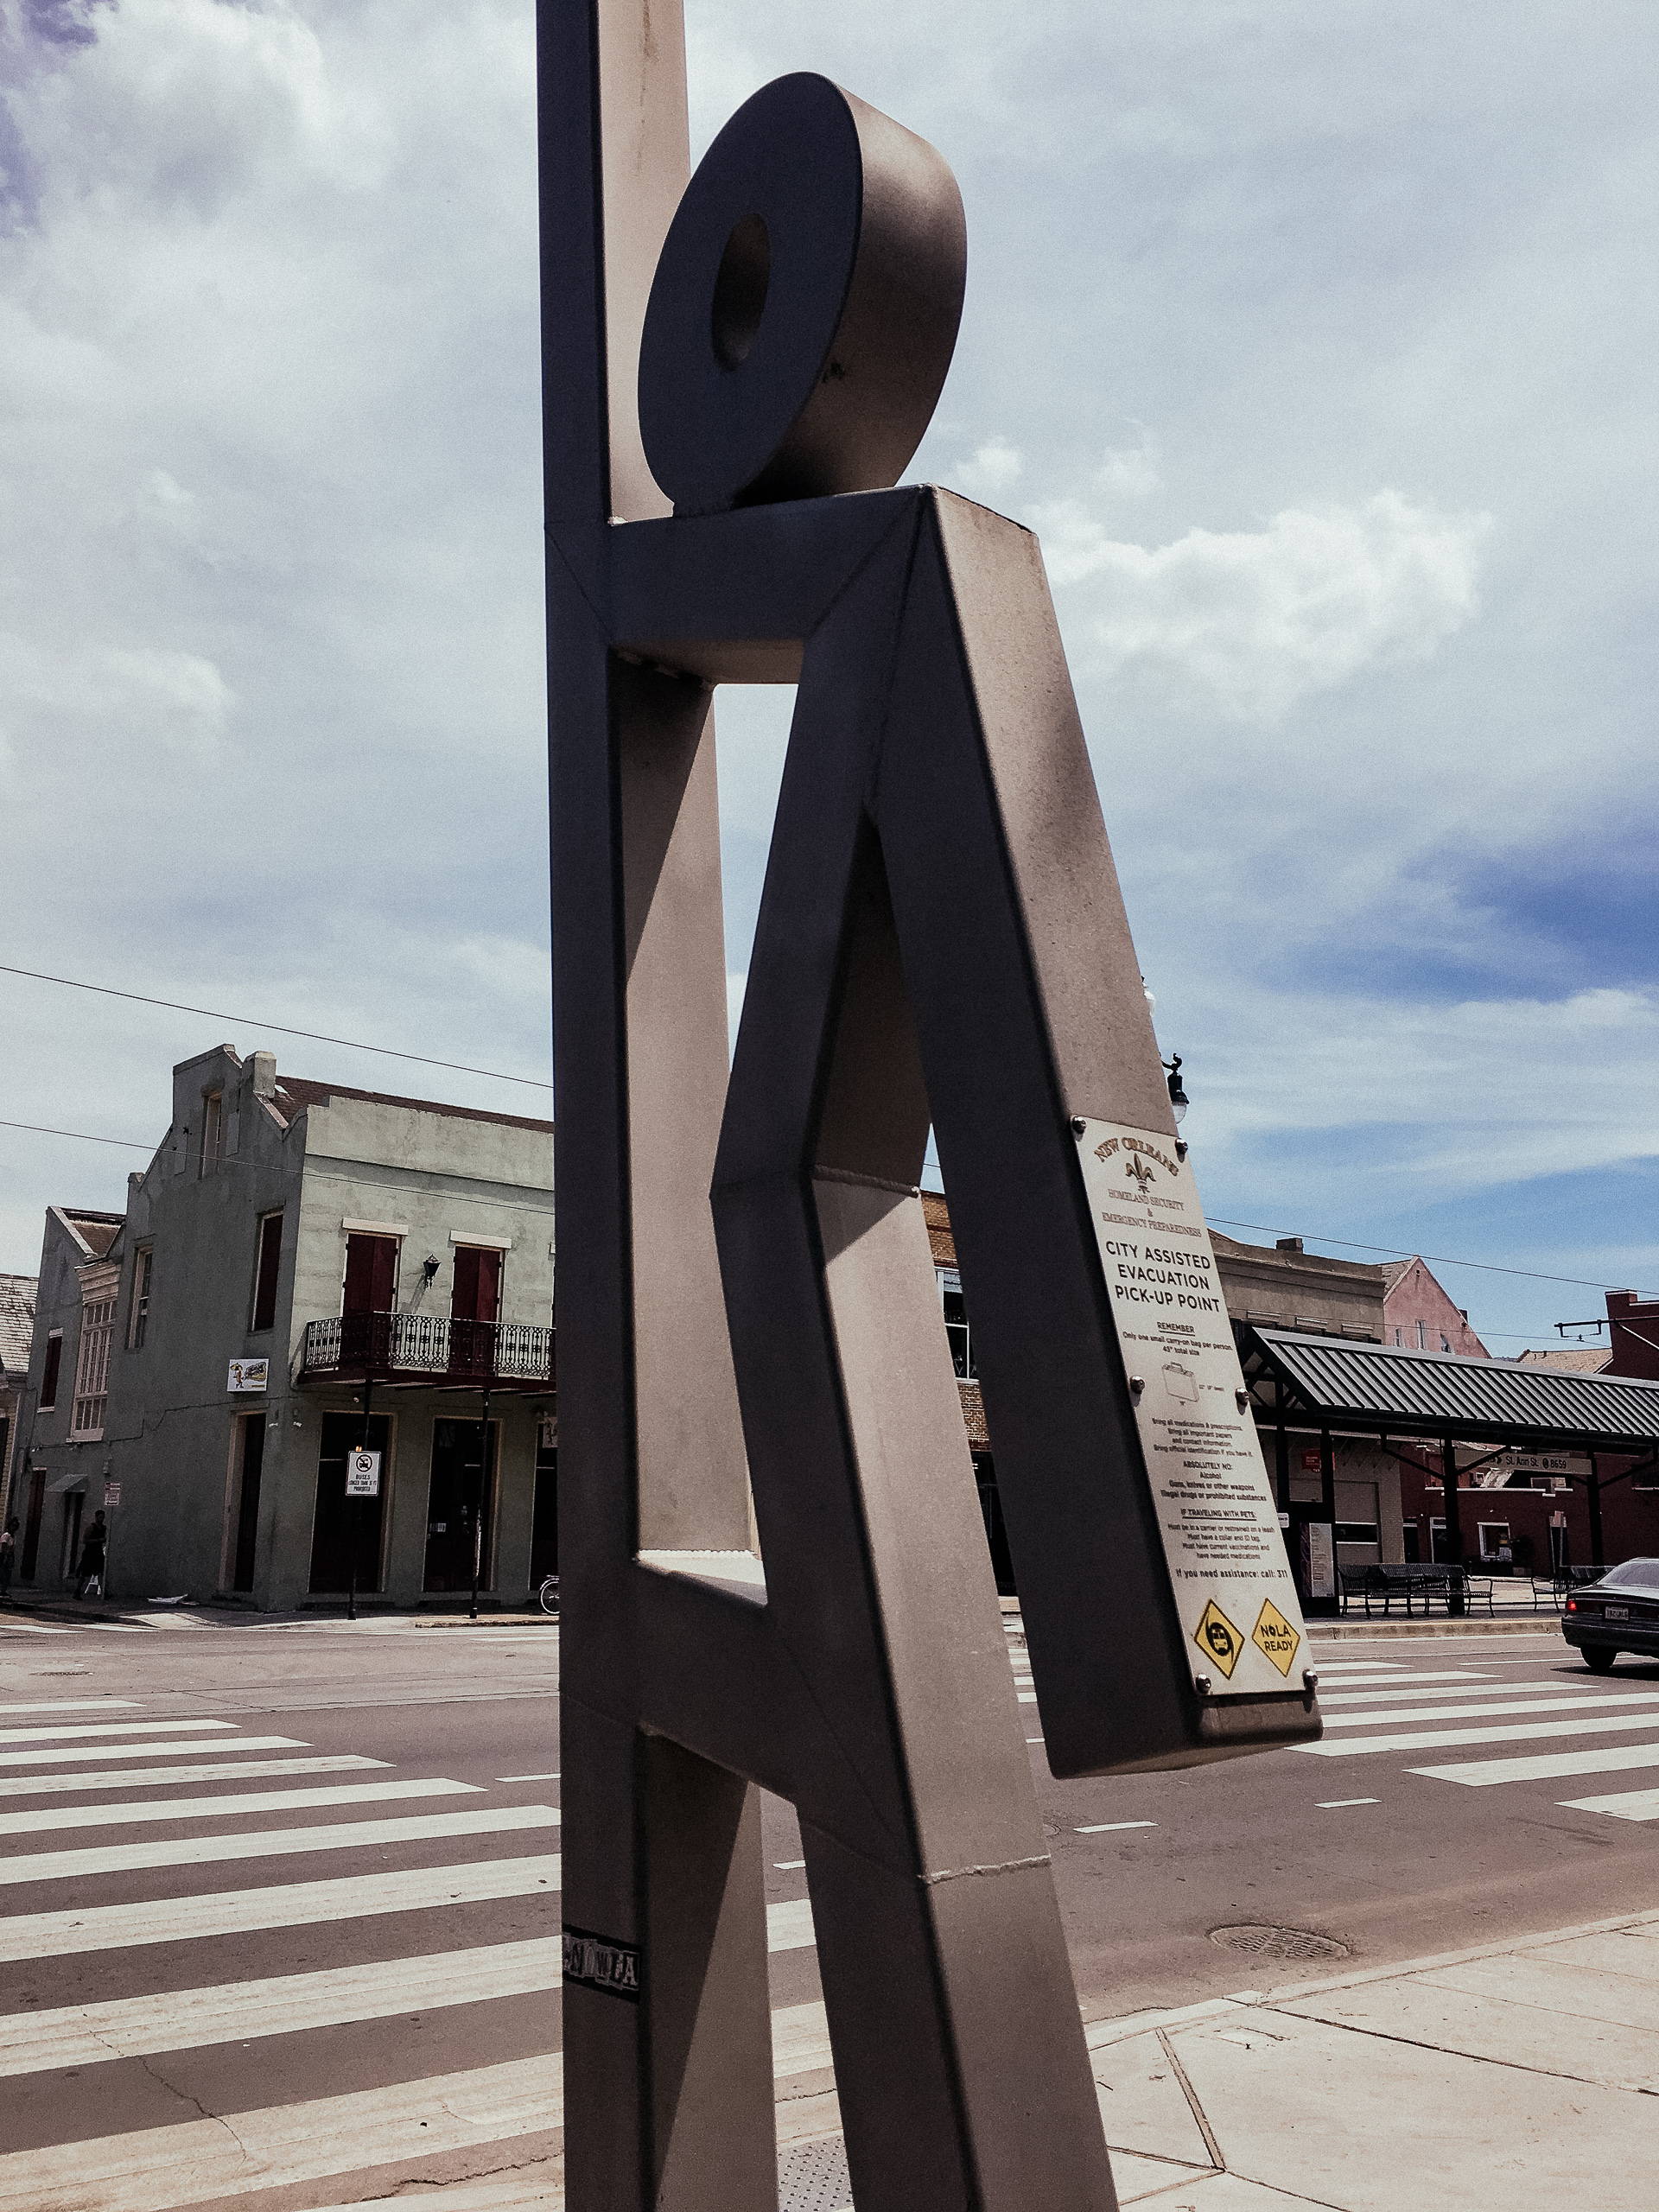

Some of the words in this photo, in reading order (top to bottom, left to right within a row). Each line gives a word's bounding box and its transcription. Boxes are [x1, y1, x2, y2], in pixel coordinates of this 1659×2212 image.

[1093, 1138, 1120, 1162] NEW
[1122, 1137, 1179, 1176] ORLEANS
[1108, 1189, 1149, 1205] HOMELAND
[1150, 1196, 1185, 1211] SECURITY
[1147, 1208, 1154, 1217] &
[1102, 1211, 1147, 1228] EMERGENCY
[1147, 1219, 1202, 1237] PREPAREDNESS
[1106, 1241, 1138, 1258] CITY
[1145, 1247, 1211, 1269] ASSISTED
[1117, 1263, 1210, 1290] EVACUATION
[1115, 1285, 1173, 1306] PICK-UP
[1177, 1294, 1220, 1313] POINT
[1157, 1322, 1195, 1333] REMEMBER
[1122, 1332, 1136, 1340] Only
[1190, 1339, 1202, 1348] bag
[1183, 1460, 1220, 1469] ABSOLUTELY
[1516, 1456, 1529, 1466] Ann
[1550, 1459, 1567, 1469] 8659
[1176, 1568, 1182, 1578] If
[1184, 1570, 1198, 1580] you
[1200, 1569, 1219, 1578] need
[1261, 1624, 1291, 1637] NOLA
[1264, 1640, 1293, 1651] READY
